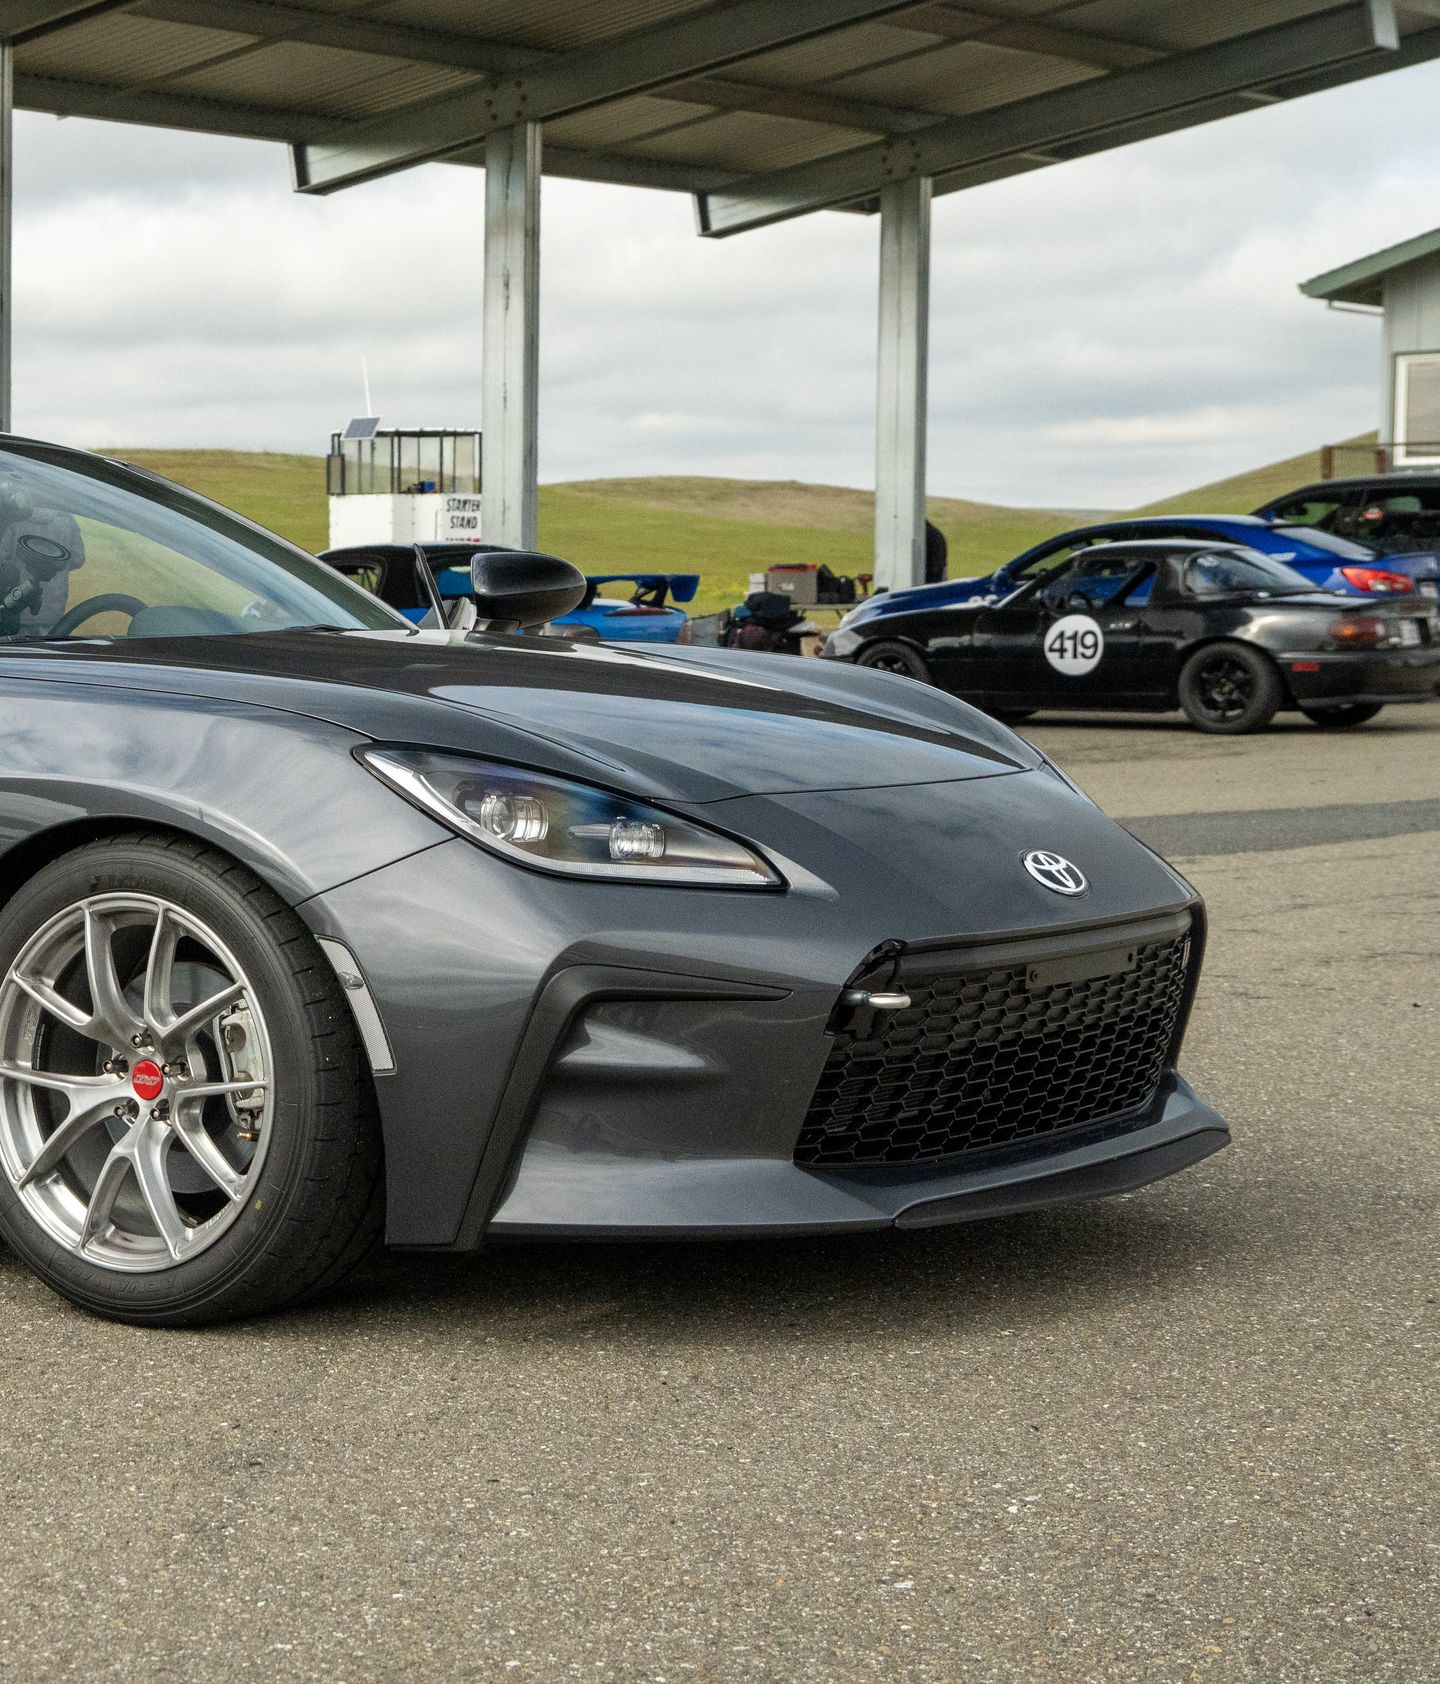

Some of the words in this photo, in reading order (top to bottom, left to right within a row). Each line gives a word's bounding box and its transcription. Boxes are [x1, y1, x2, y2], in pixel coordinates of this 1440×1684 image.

[446, 498, 480, 512] STARTER
[450, 515, 478, 529] STAND
[1048, 629, 1099, 660] 419
